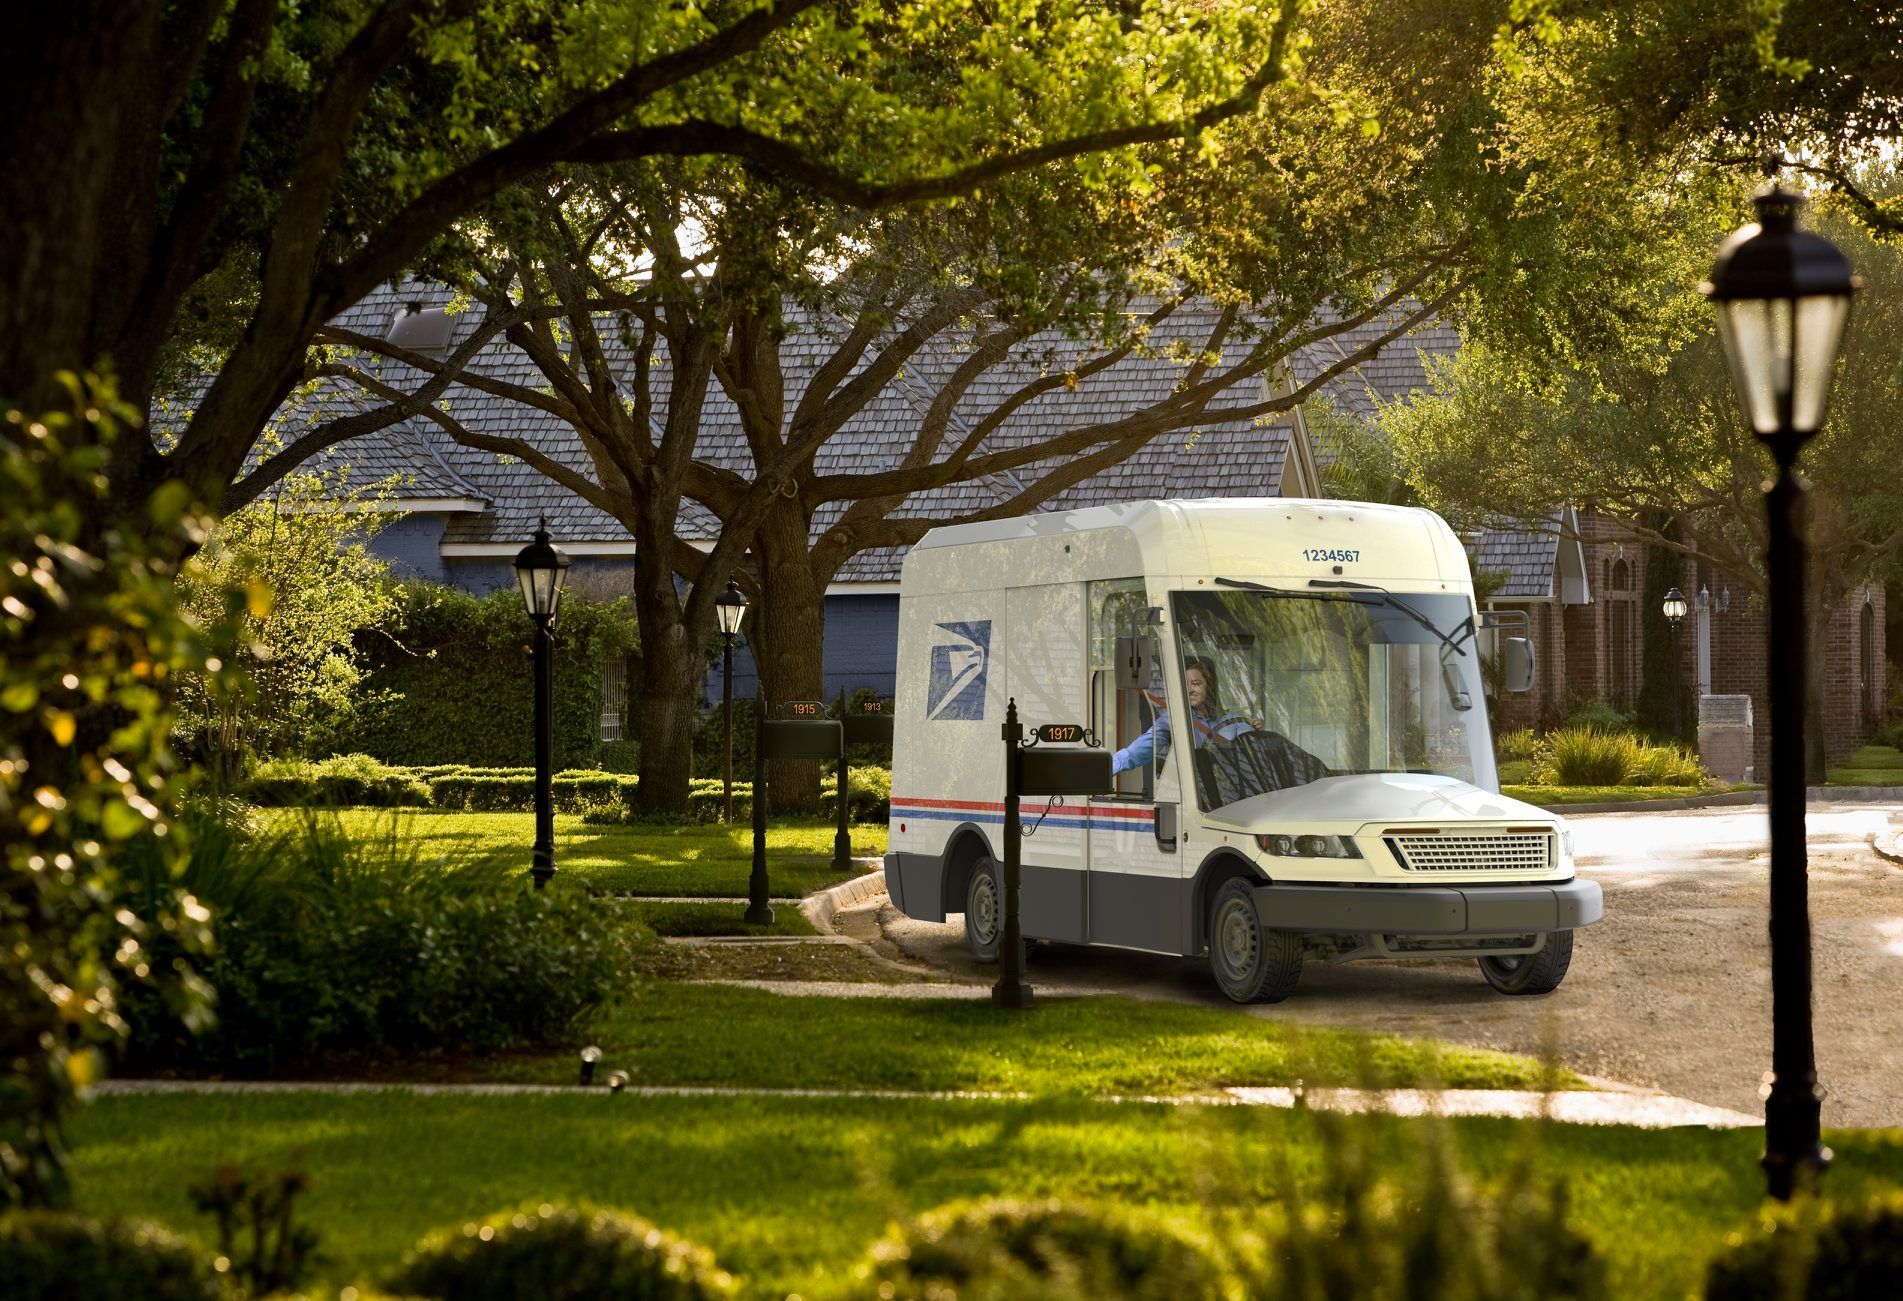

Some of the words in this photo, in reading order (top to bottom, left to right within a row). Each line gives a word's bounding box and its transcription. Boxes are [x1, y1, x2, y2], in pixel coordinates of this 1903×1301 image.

[1302, 549, 1360, 562] 1234567
[793, 704, 815, 714] 1915
[863, 702, 881, 711] 1913
[1048, 727, 1075, 740] 1917
